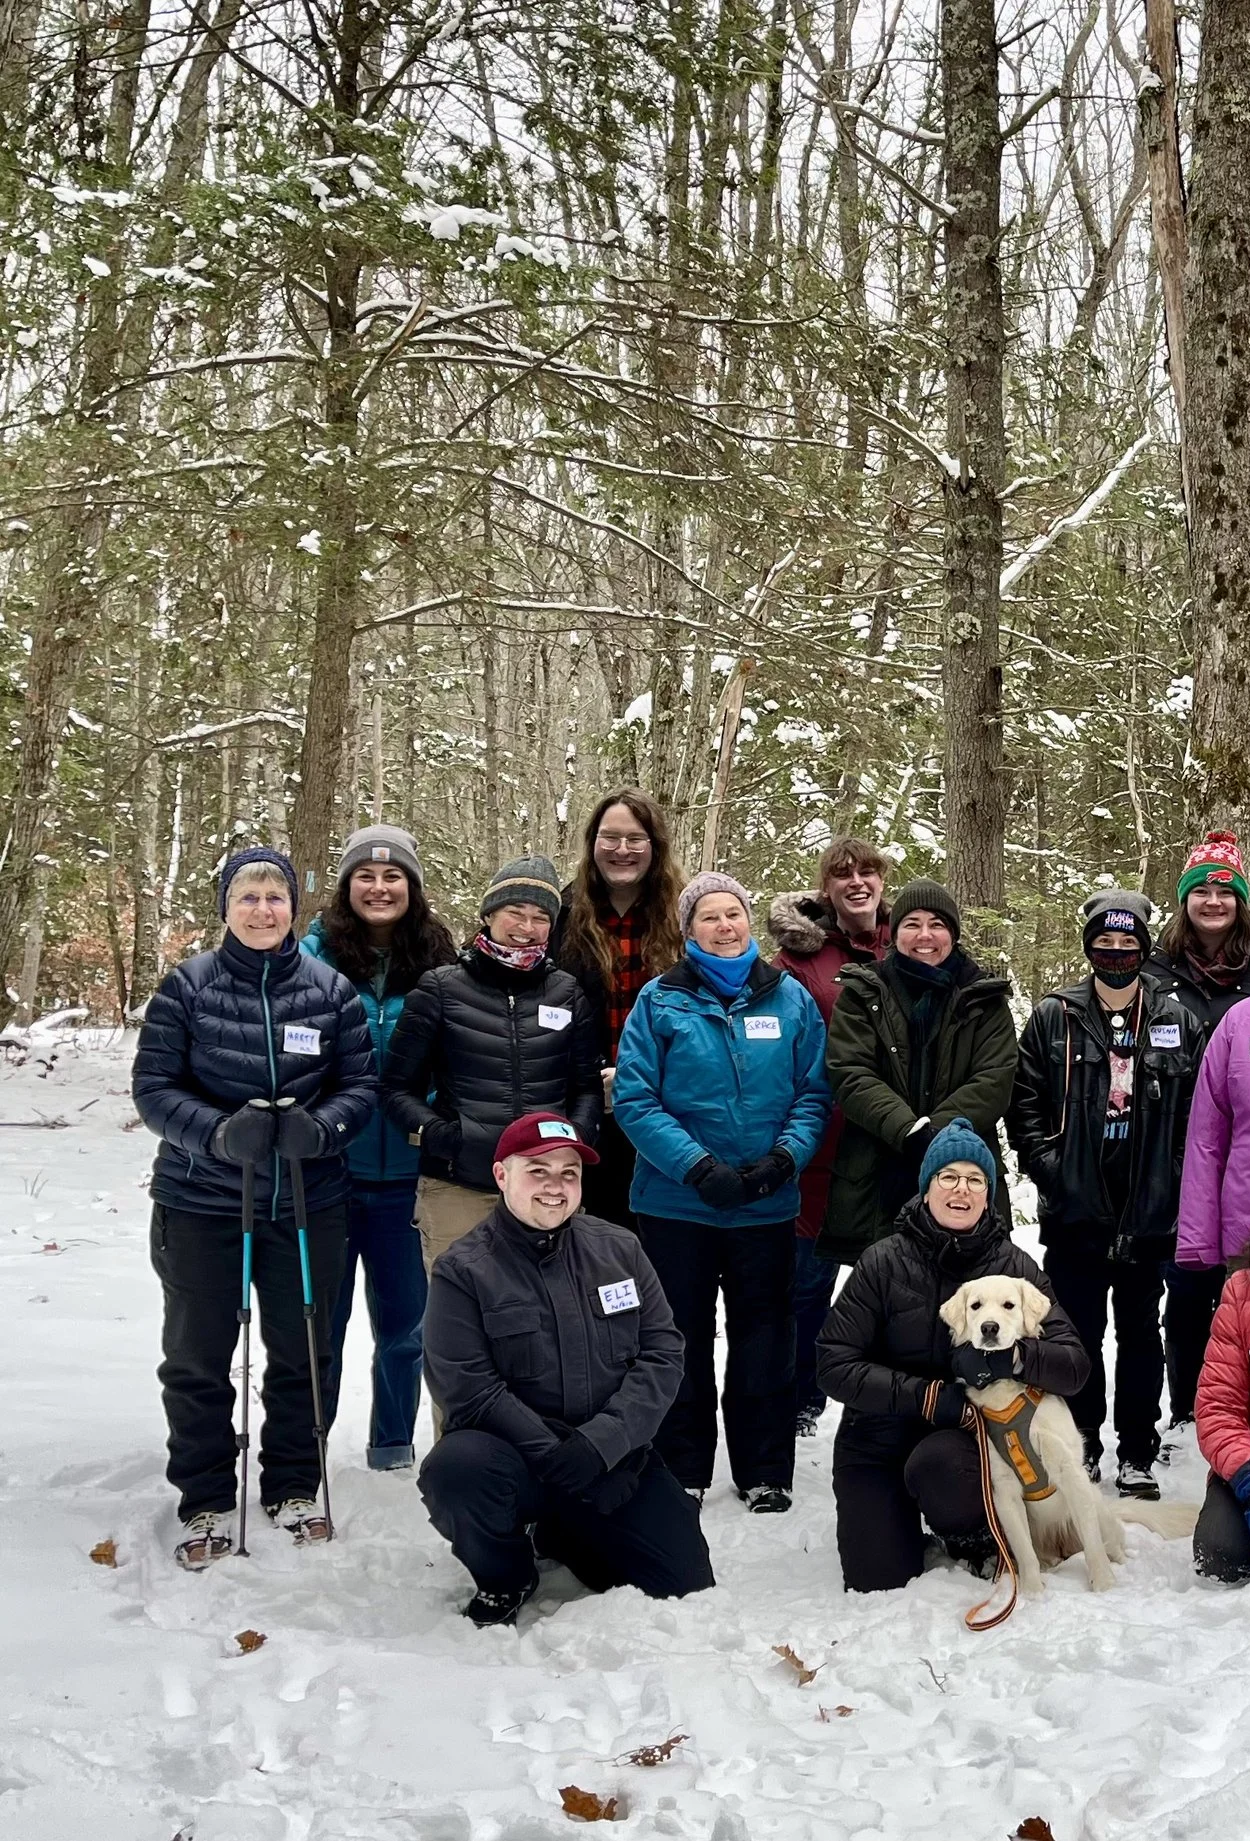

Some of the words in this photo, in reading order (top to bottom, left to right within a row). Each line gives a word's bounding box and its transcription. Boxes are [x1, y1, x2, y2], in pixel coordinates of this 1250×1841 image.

[745, 1020, 778, 1031] GRACE
[1150, 1027, 1178, 1035] QUINN
[287, 1031, 315, 1046] MARTY
[604, 1284, 632, 1302] ELI
